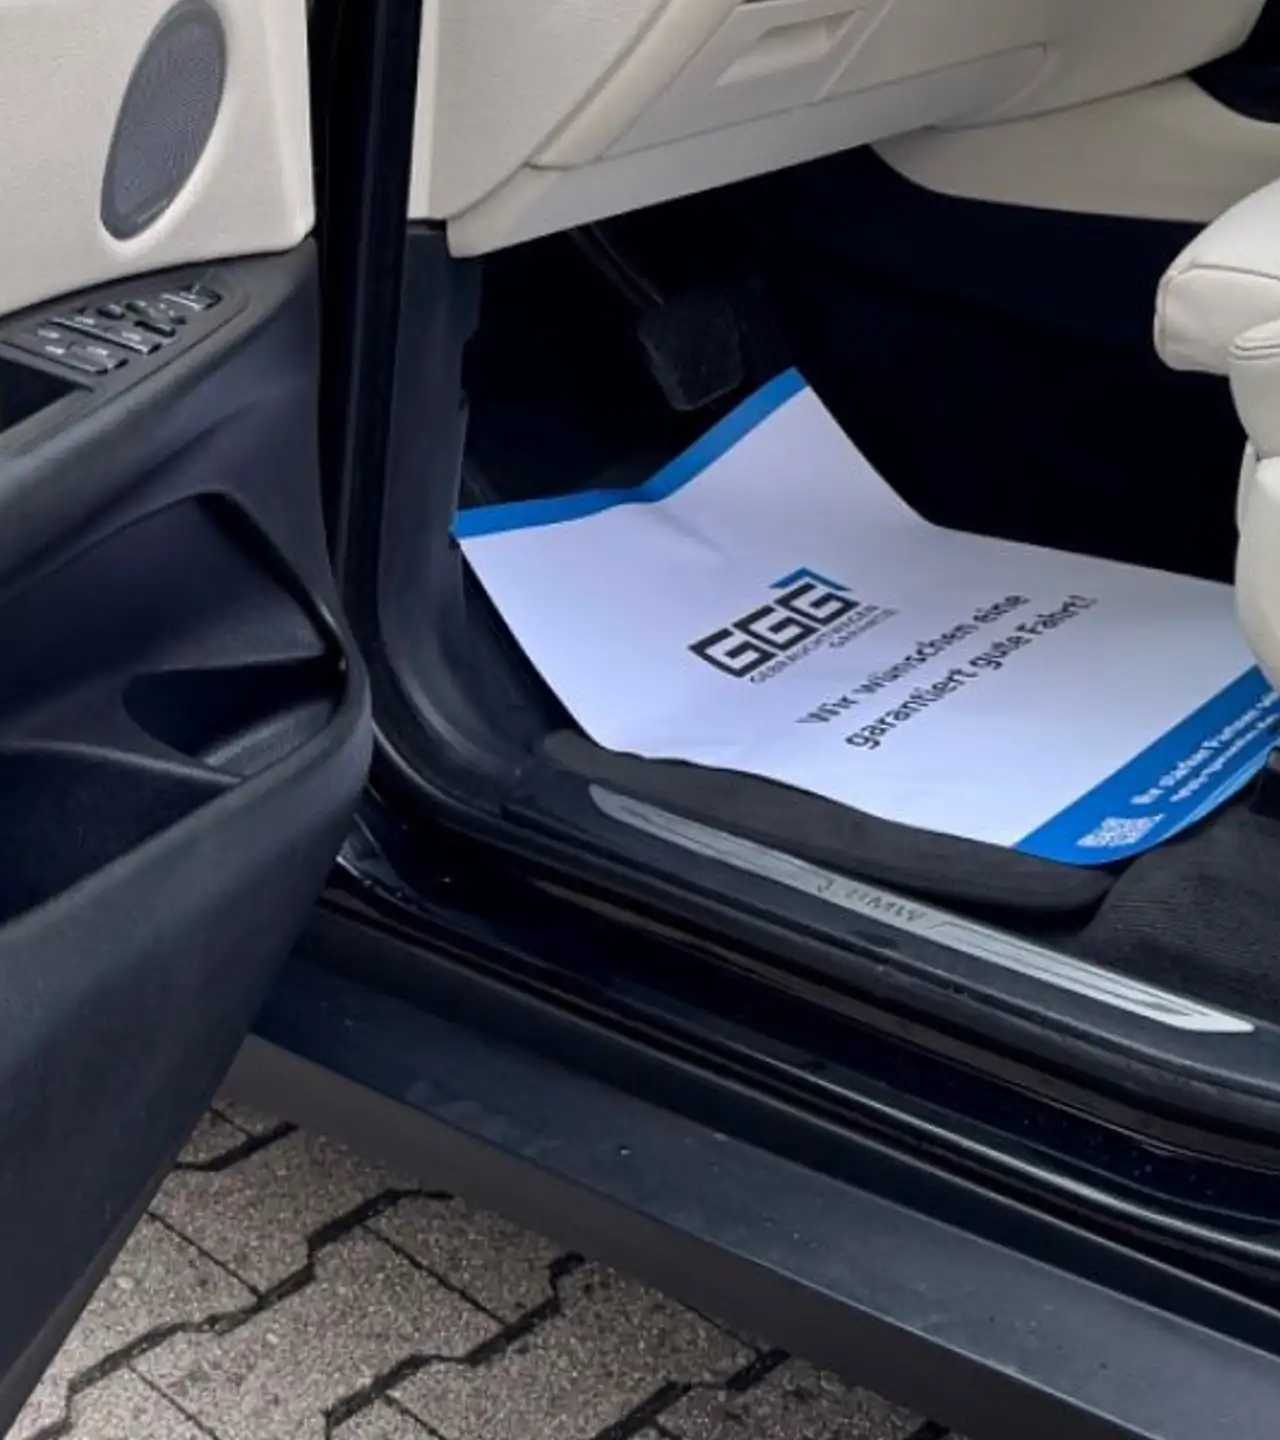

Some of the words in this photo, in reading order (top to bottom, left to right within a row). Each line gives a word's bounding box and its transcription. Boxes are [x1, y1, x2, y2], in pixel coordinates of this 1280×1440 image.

[688, 580, 861, 679] GGG
[794, 693, 860, 724] Wir
[972, 595, 1031, 624] eine
[844, 667, 979, 750] garantiert
[969, 635, 1033, 670] gute
